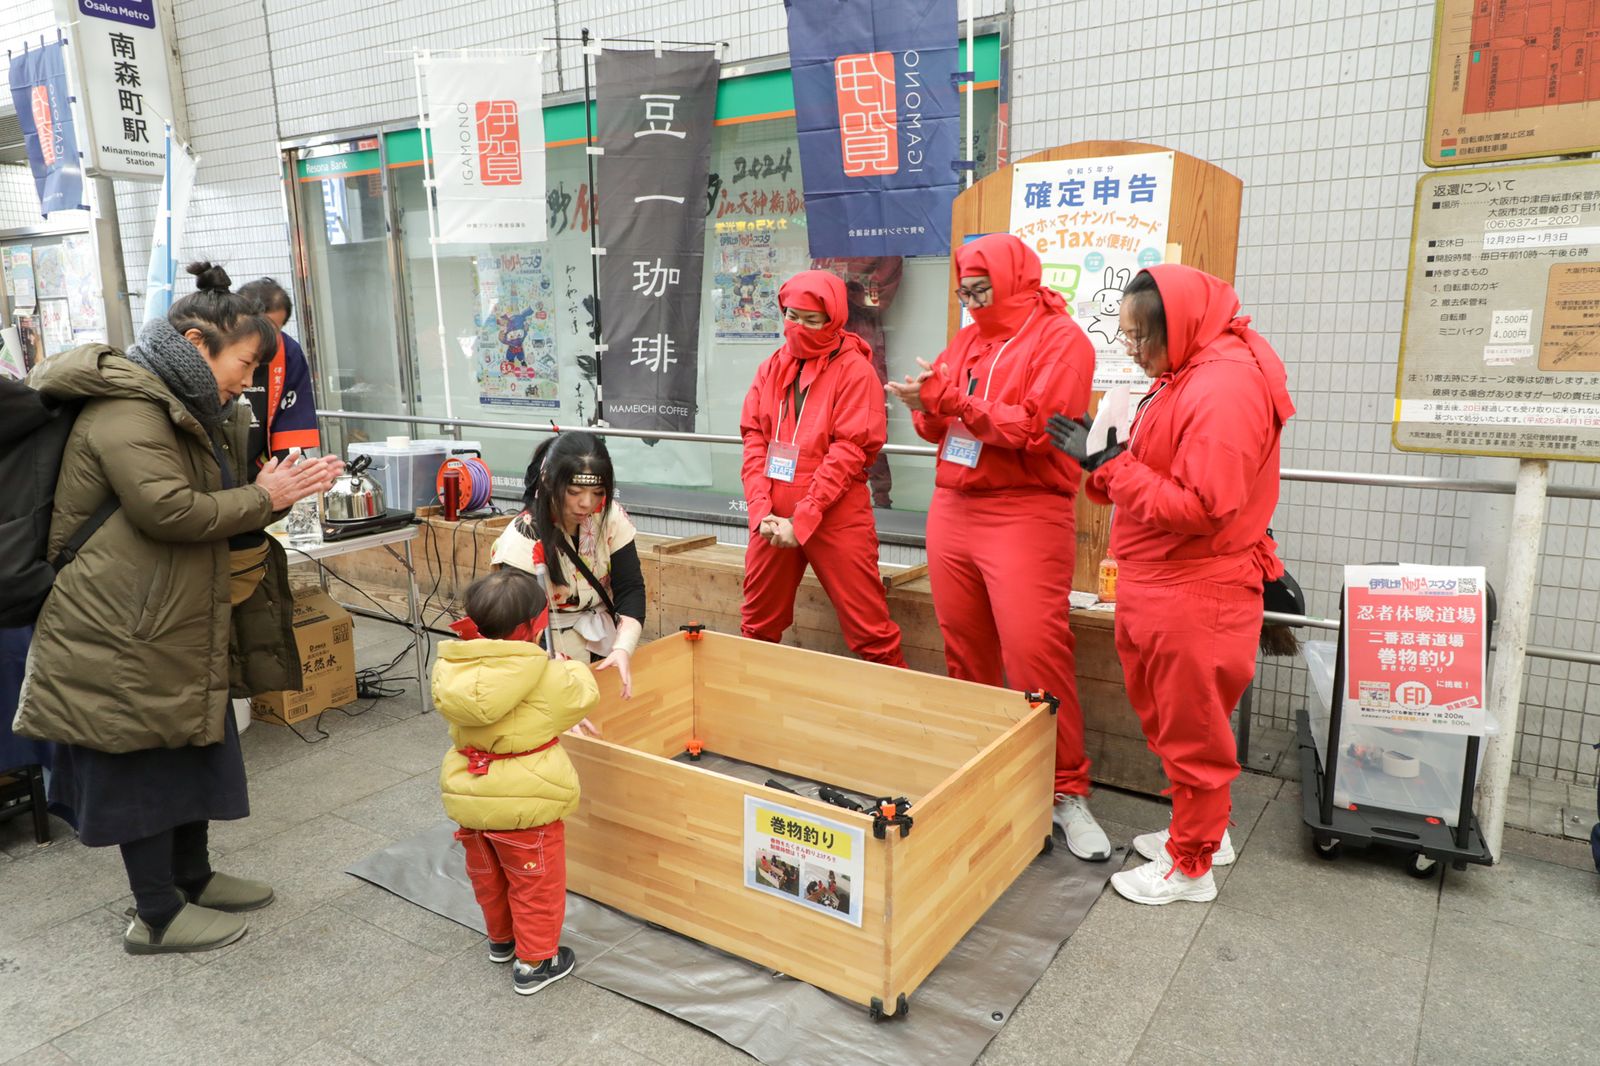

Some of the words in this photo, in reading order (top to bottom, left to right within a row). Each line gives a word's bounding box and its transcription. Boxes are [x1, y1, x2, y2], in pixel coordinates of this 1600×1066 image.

[84, 0, 118, 14] Osaka
[119, 7, 150, 21] Metro
[109, 33, 150, 144] 南森町駅
[457, 102, 474, 186] IGAMONO
[475, 97, 523, 186] 伊賀
[126, 157, 155, 167] Station
[330, 160, 348, 171] Bank
[1024, 173, 1157, 209] 確定申告
[1433, 179, 1516, 197] 返還について
[630, 94, 687, 374] 豆一珈琲
[1015, 211, 1162, 240] スマホ×マイナンバーカード
[1436, 238, 1463, 248] 定休日
[1443, 282, 1499, 292] 自転車のカギ
[1440, 313, 1467, 321] 自転車
[1439, 327, 1484, 336] ミニバイク
[609, 404, 657, 413] MAMEICHI
[658, 405, 688, 417] COFFEE
[946, 446, 977, 459] STAFF
[769, 464, 793, 475] STAFF
[1357, 605, 1476, 623] 忍者体験道場
[1368, 631, 1464, 647] 二番忍者道場
[1377, 647, 1455, 667] 巻物釣り
[1403, 687, 1425, 705] 印
[770, 815, 835, 850] 巻物釣り
